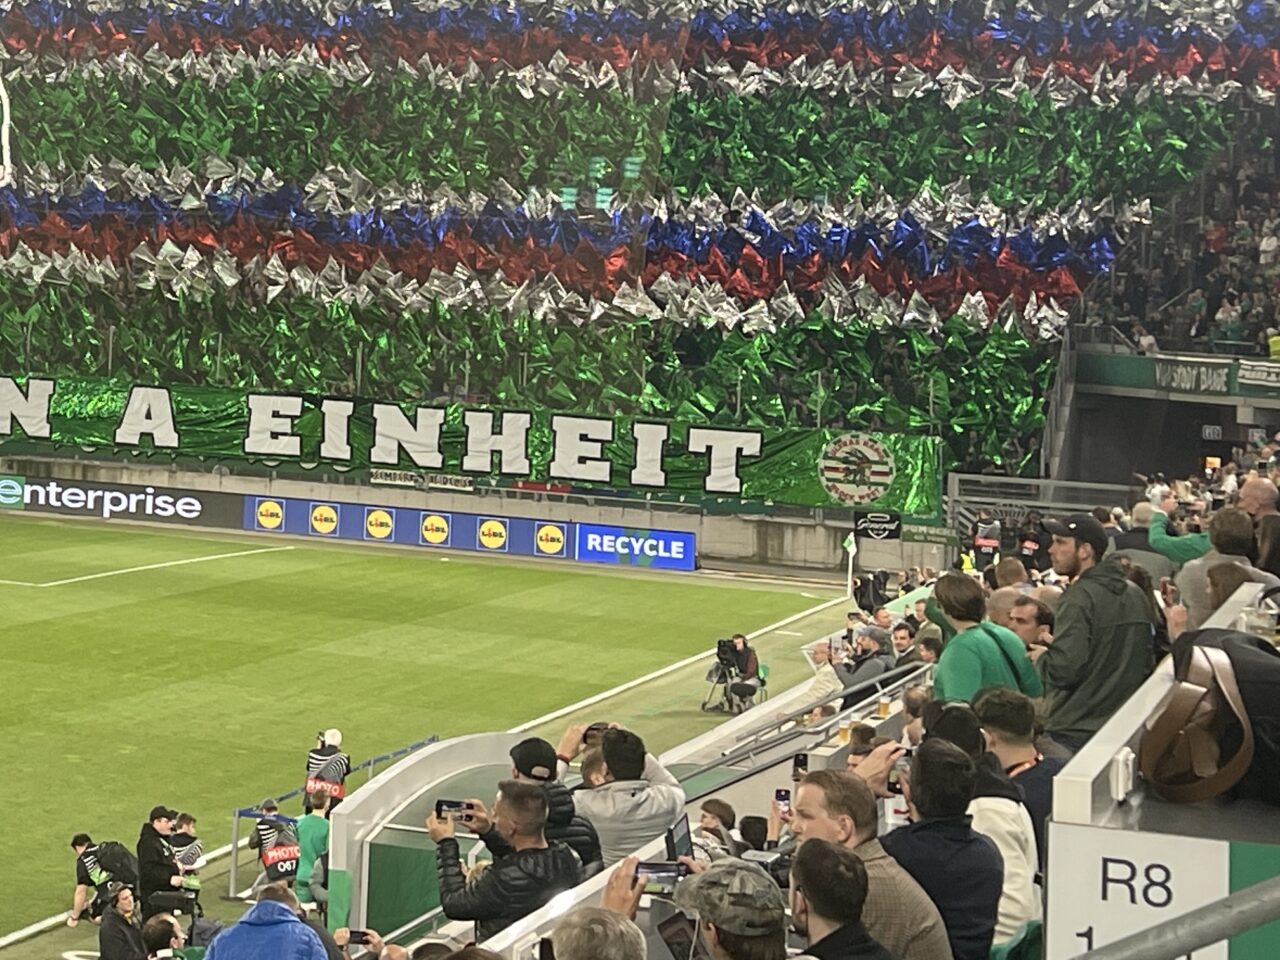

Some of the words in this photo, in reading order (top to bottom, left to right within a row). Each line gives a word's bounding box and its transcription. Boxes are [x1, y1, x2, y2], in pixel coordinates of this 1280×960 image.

[115, 386, 179, 448] A
[244, 394, 762, 493] EINHEIT
[586, 533, 685, 559] RECYCLE
[307, 779, 340, 795] PHOTO
[268, 846, 300, 859] PHOTO
[1101, 856, 1173, 908] R8
